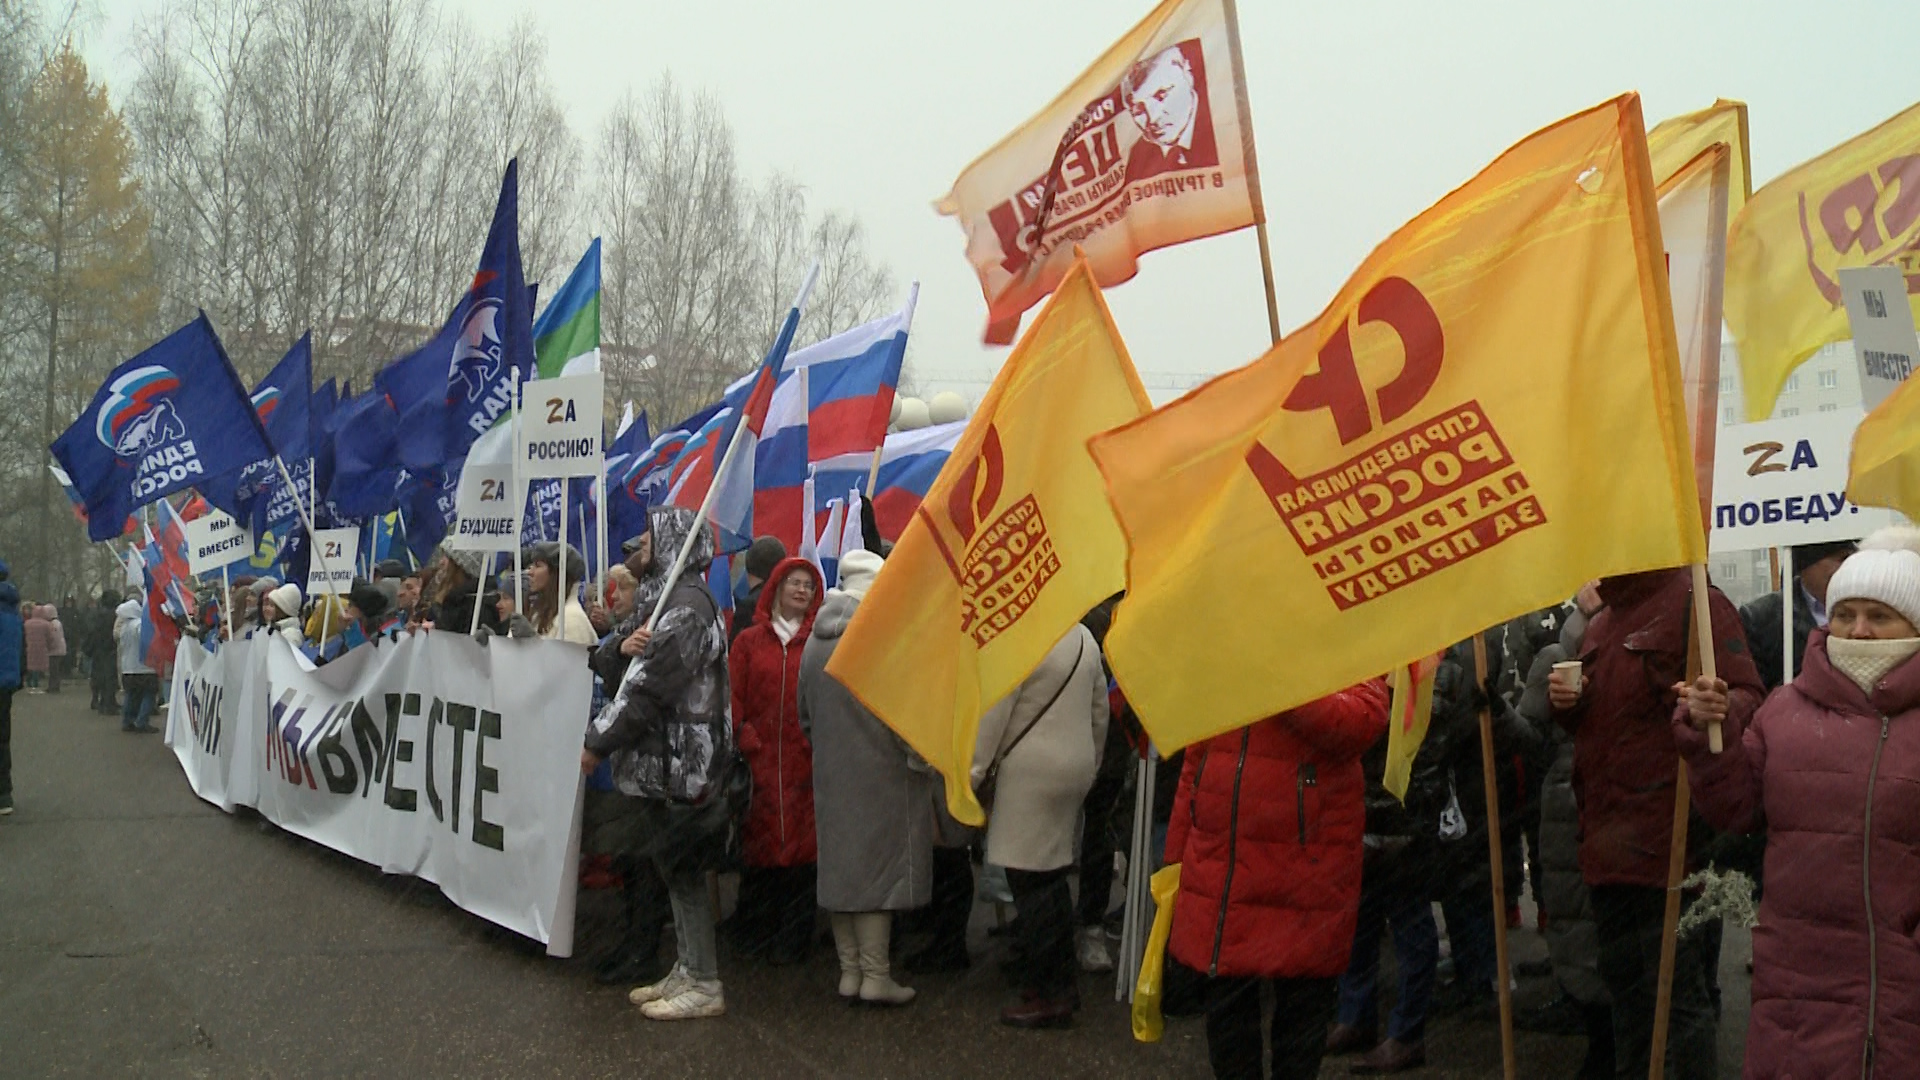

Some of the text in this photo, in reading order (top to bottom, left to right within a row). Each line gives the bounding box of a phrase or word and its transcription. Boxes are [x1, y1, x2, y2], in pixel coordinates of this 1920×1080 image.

[1862, 289, 1887, 318] МЫ
[528, 437, 594, 460] РОССИЮ!
[210, 518, 230, 532] МЫ
[460, 517, 514, 537] БУДУЩЕЕ
[199, 534, 244, 558] ВМЕСТЕ!
